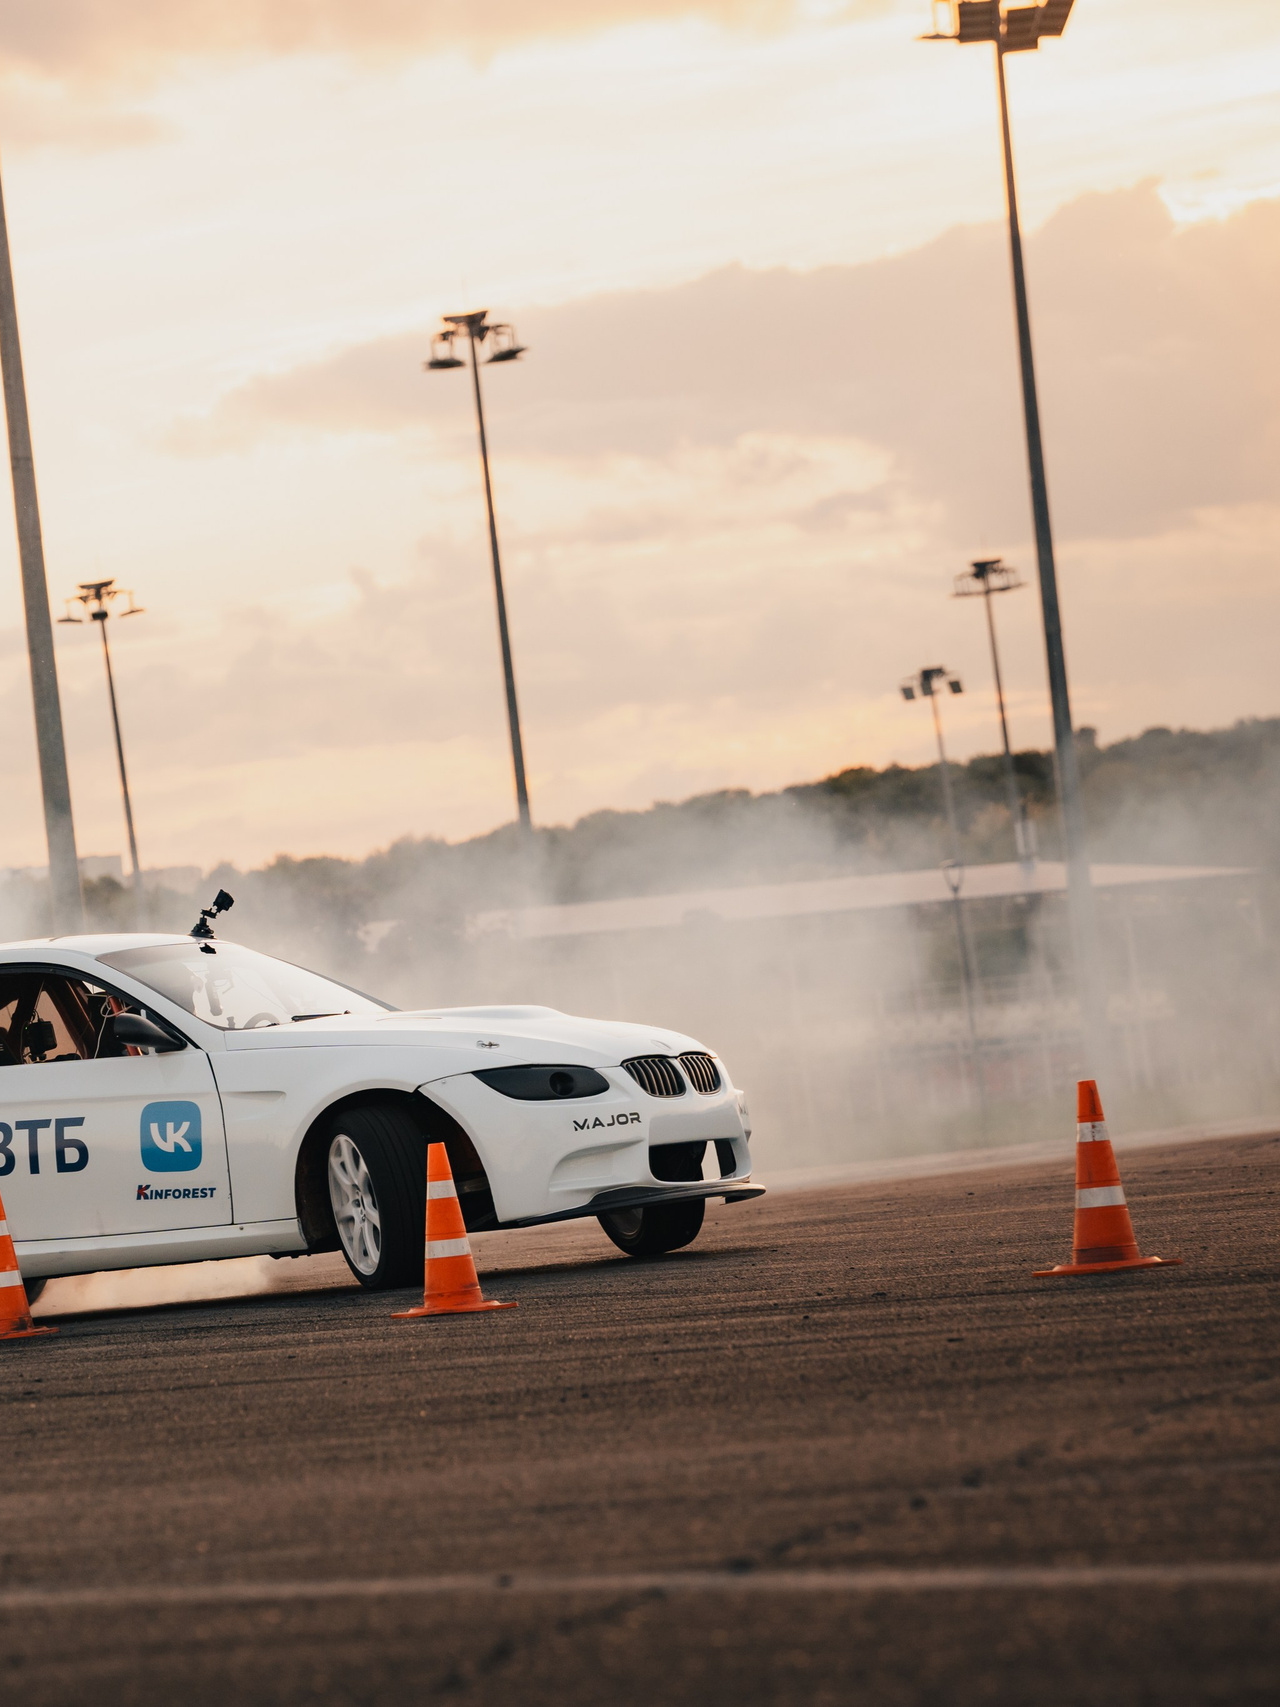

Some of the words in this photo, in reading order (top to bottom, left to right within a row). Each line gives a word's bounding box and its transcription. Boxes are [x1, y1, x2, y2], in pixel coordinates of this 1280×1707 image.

[572, 1111, 642, 1132] MAJOR
[149, 1121, 193, 1153] VK
[136, 1184, 217, 1201] KINFOREST
